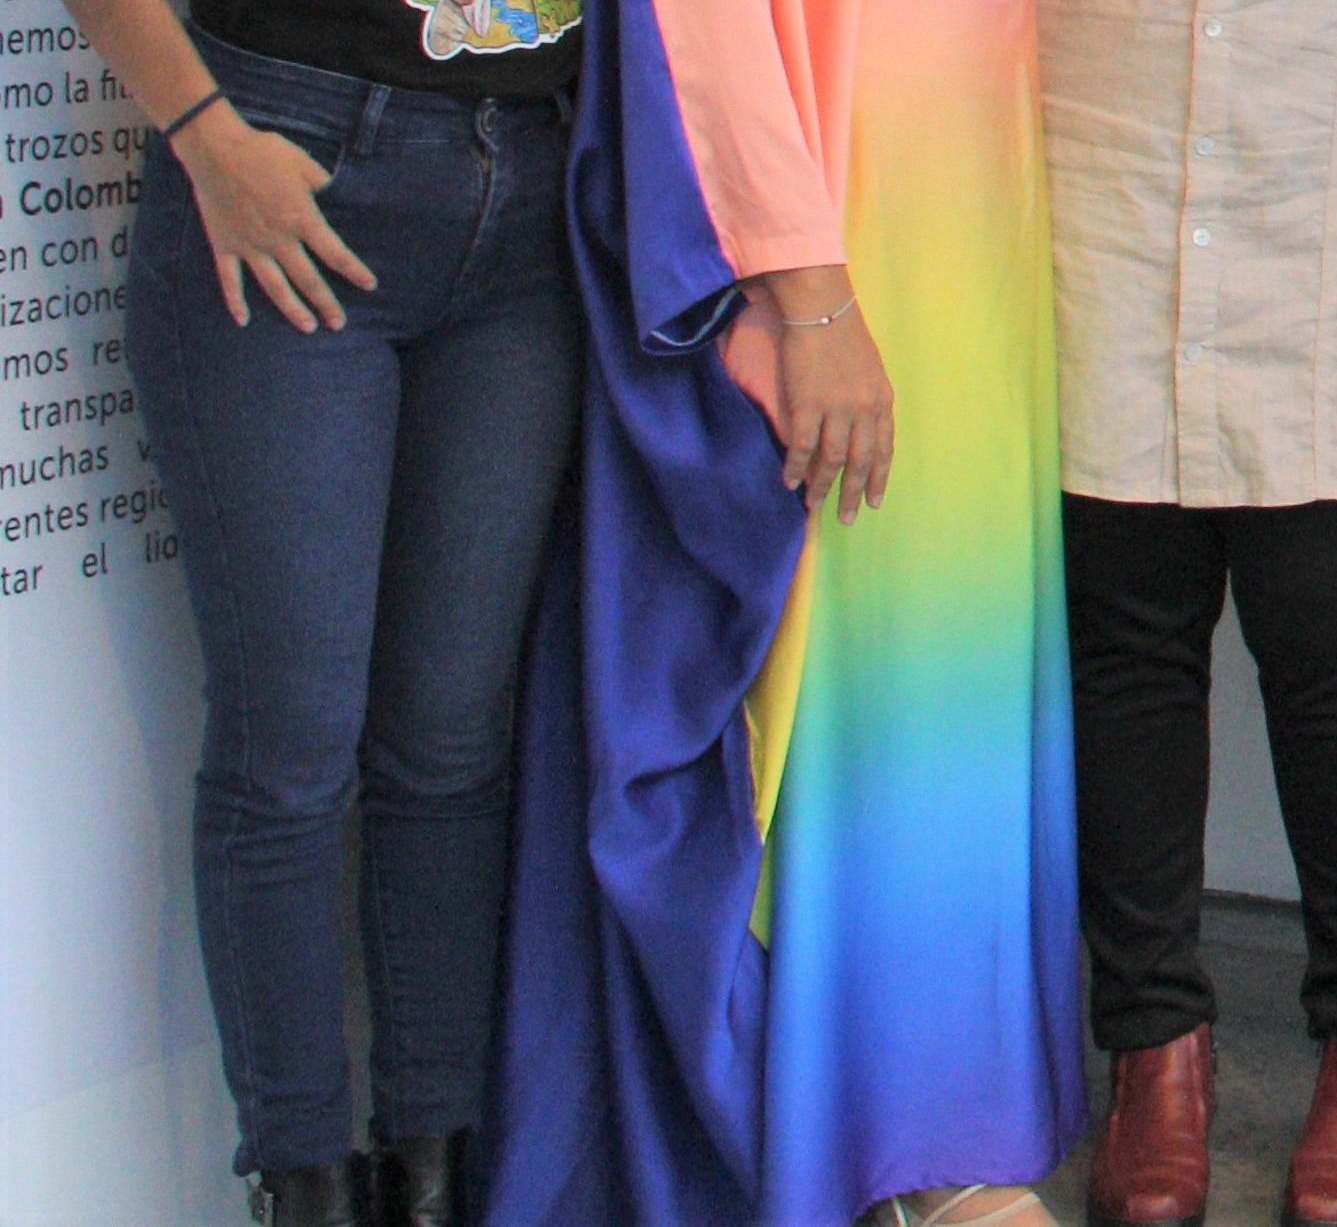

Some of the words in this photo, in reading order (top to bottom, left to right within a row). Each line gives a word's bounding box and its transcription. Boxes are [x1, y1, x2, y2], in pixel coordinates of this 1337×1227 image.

[4, 130, 104, 164] trozos
[40, 236, 98, 267] con
[0, 502, 89, 542] entes
[80, 542, 108, 578] el
